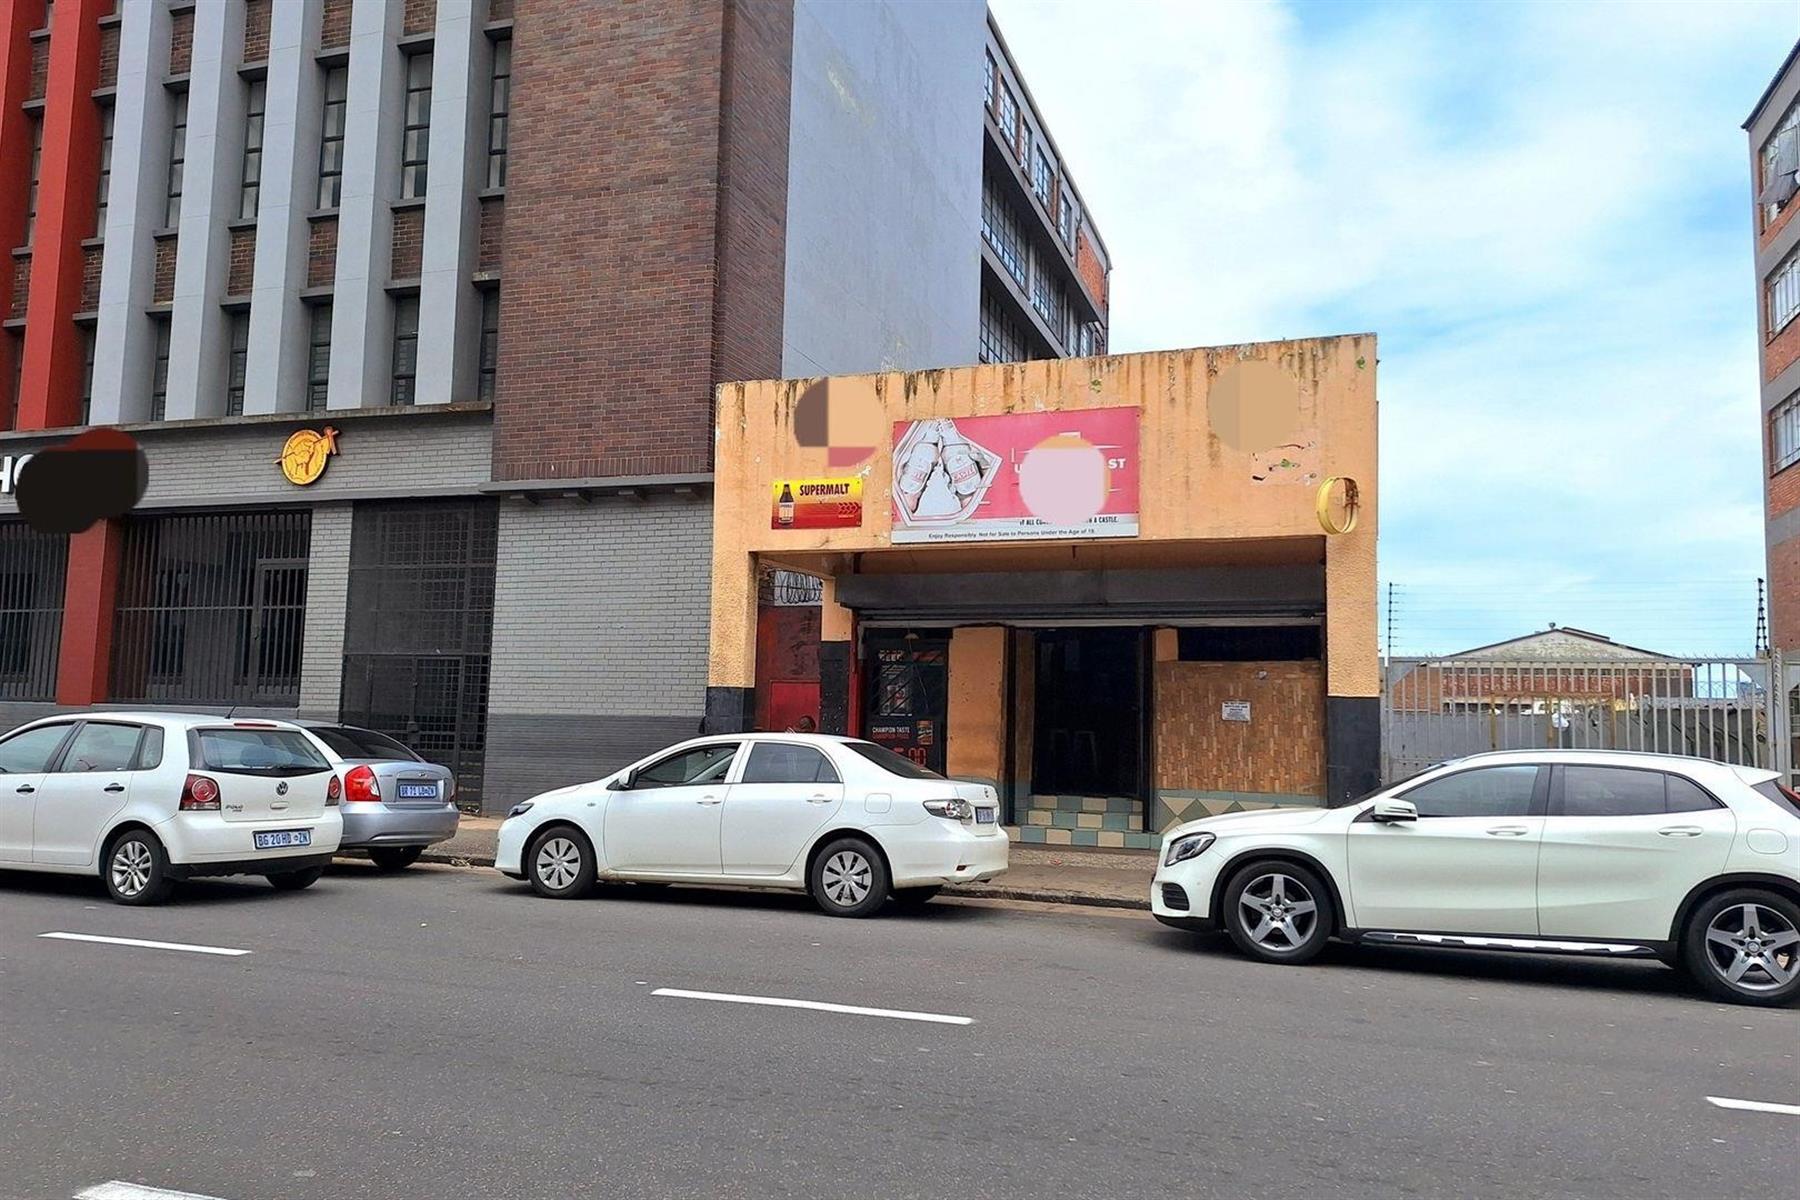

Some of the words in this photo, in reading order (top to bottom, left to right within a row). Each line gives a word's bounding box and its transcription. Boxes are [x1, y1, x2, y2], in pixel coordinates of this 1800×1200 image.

[800, 483, 850, 496] SUPERMALT
[258, 834, 269, 846] BG
[298, 832, 308, 843] ZN
